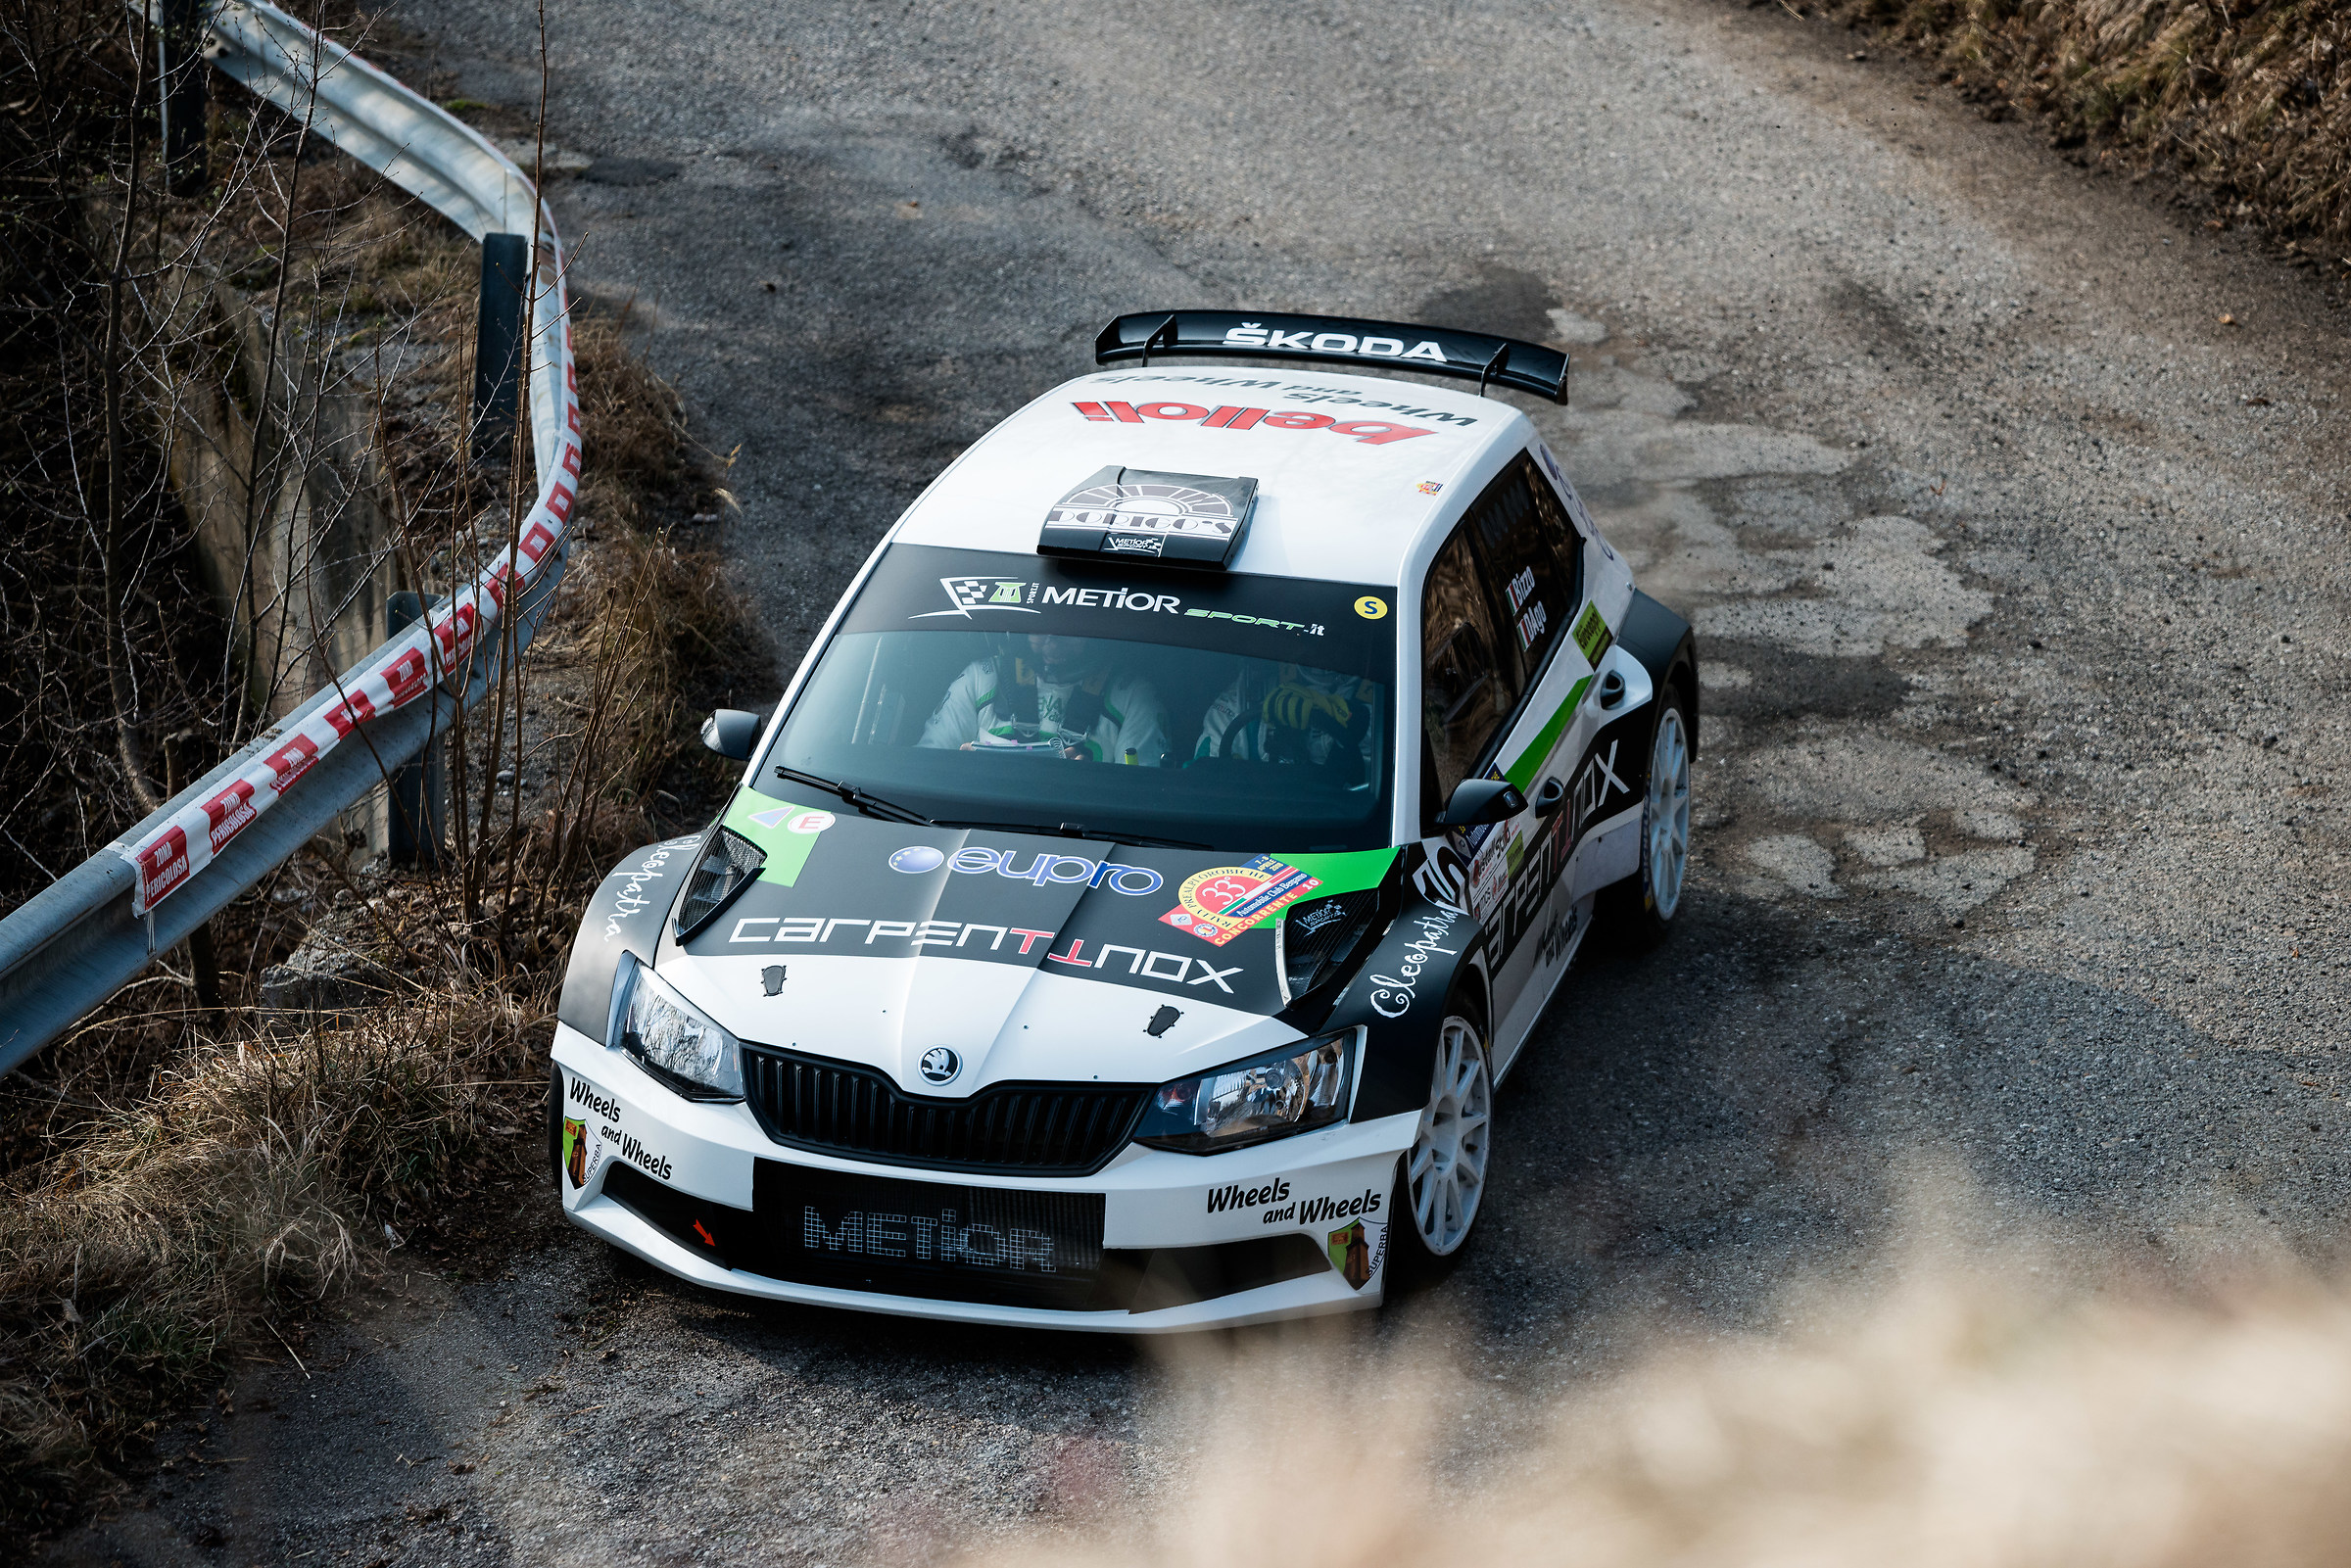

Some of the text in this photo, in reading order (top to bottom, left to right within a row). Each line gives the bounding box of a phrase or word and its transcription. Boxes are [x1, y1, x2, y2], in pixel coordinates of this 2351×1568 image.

[1223, 322, 1448, 362] ŠKODA
[1071, 401, 1438, 445] belloli
[1283, 393, 1479, 427] Wheels
[1364, 600, 1378, 615] S
[1511, 566, 1536, 606] Bizzo
[211, 801, 255, 846] PERICOLOSA
[220, 791, 241, 816] ZONA
[798, 816, 825, 830] E
[154, 841, 172, 868] ZONA
[947, 845, 1164, 897] eupro
[146, 854, 188, 902] PERICOLOSA
[603, 834, 702, 942] Cleopatra
[1236, 873, 1309, 917] Automobile Club Bergamo
[1214, 891, 1299, 945] CONCORRENTE
[1302, 879, 1320, 891] 10
[1369, 909, 1459, 1019] Cleopatra
[569, 1076, 621, 1124] Wheels
[583, 1143, 602, 1183] SUPERBA
[600, 1122, 673, 1181] and Wheels
[1207, 1177, 1291, 1214] Wheels
[1263, 1188, 1382, 1225] and Wheels
[1366, 1224, 1389, 1276] SUPERBA
